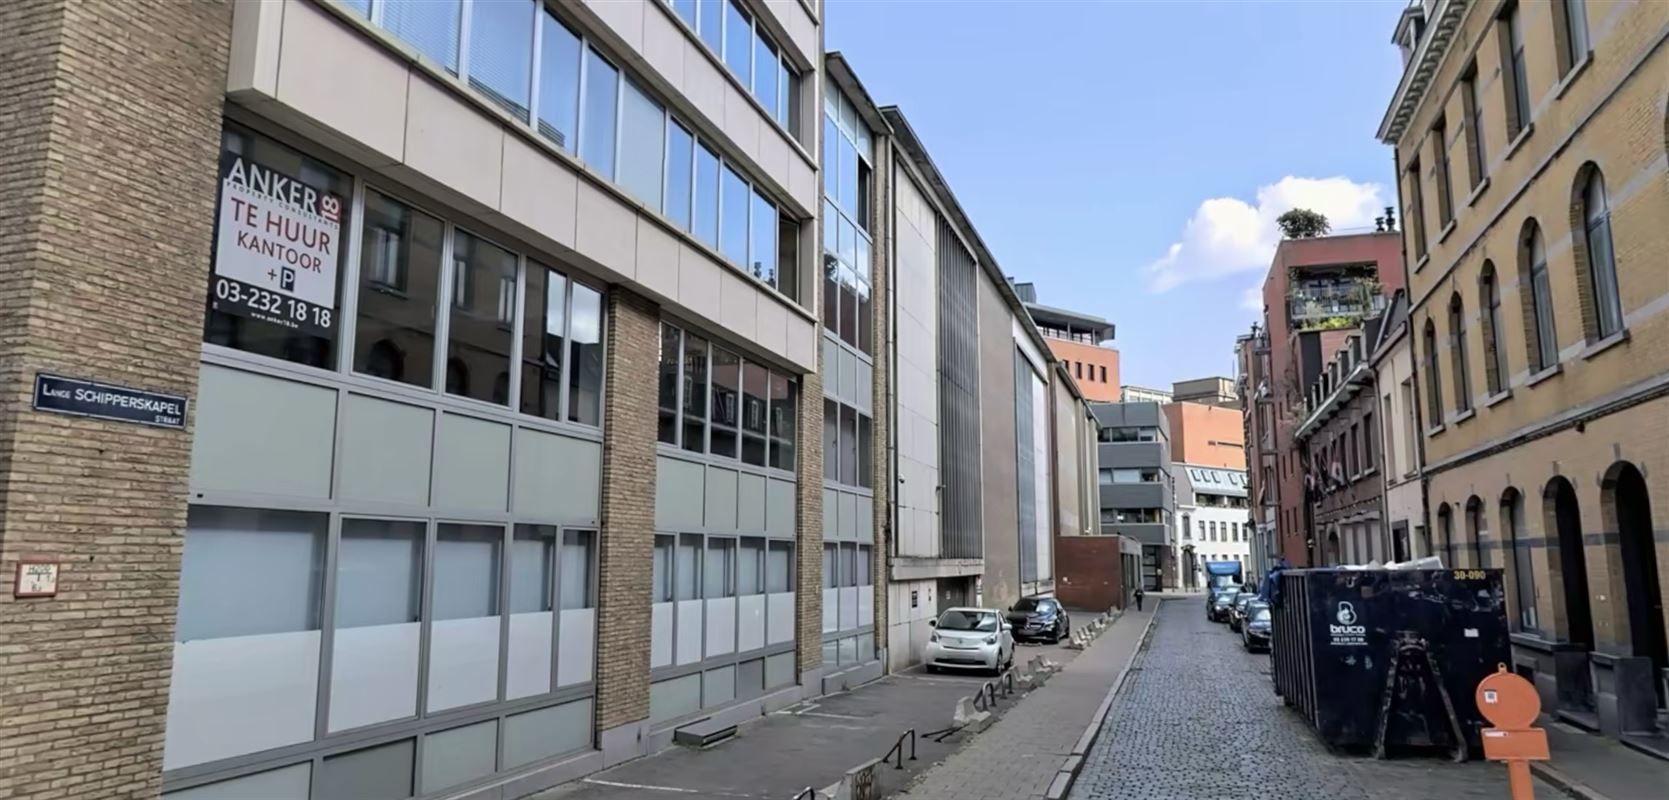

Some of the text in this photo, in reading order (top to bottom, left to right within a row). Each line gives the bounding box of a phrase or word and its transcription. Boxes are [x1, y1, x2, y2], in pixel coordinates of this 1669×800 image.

[227, 157, 319, 217] ANKER
[231, 197, 330, 255] TE HUUR
[278, 202, 339, 231] CONSULTANTS
[237, 231, 321, 274] KANTOOR
[216, 279, 331, 328] 03-232 18 18
[74, 388, 181, 416] SCHIPPERSKAPEL
[155, 415, 180, 425] STRAAT
[1330, 624, 1366, 634] bruco
